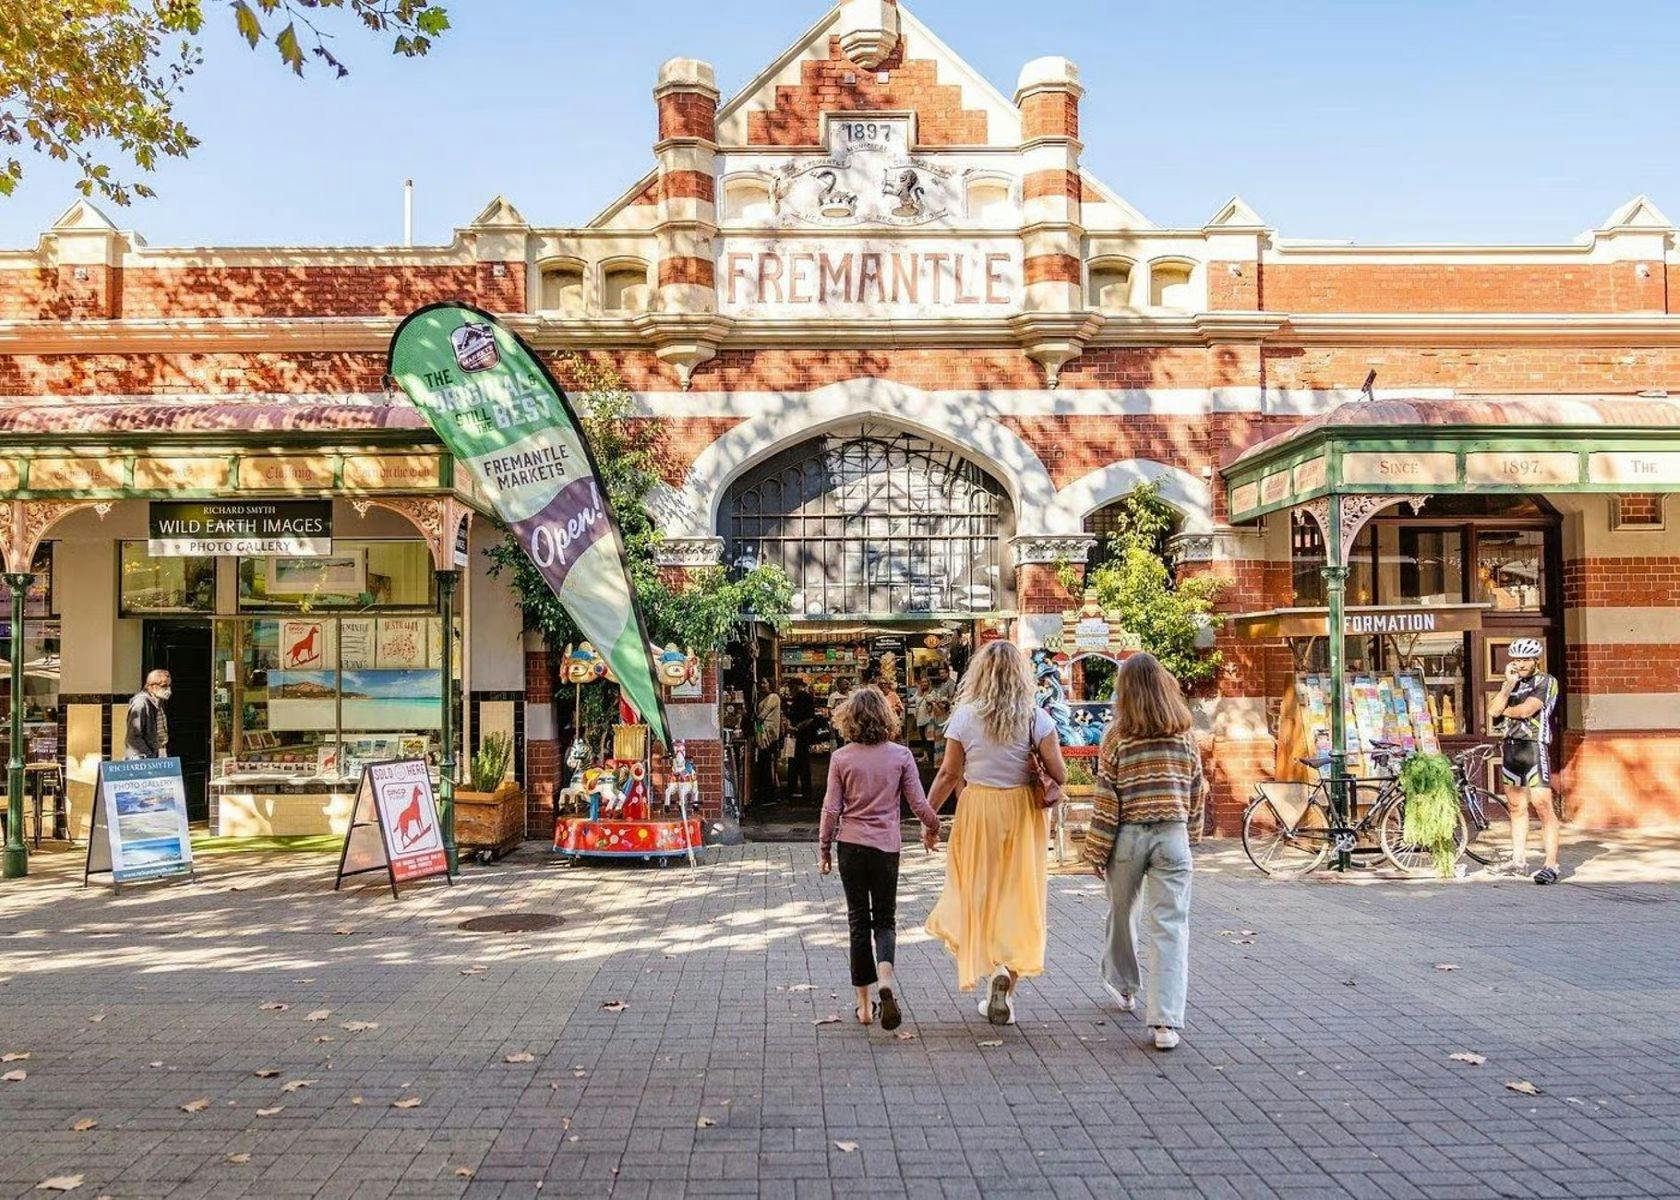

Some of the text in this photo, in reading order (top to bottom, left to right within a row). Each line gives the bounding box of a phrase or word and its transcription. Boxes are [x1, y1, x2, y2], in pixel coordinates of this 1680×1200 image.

[843, 122, 892, 143] 1897
[726, 251, 1012, 305] FREMANTLE
[424, 369, 453, 388] THE
[455, 393, 552, 429] STILL BEST
[475, 421, 494, 434] THE
[483, 444, 570, 477] FREMANTLE
[496, 462, 566, 492] MARKETS
[203, 505, 276, 515] RICHARD SMYTH
[158, 518, 323, 534] WILD EARTH IMAGES
[530, 481, 604, 568] Open!
[190, 541, 291, 552] PHOTO GALLERY
[1325, 613, 1435, 633] IFORMATION
[109, 760, 175, 772] RICHARD SMYTH
[374, 763, 425, 780] SOLD HERE
[142, 780, 173, 789] GALLERY
